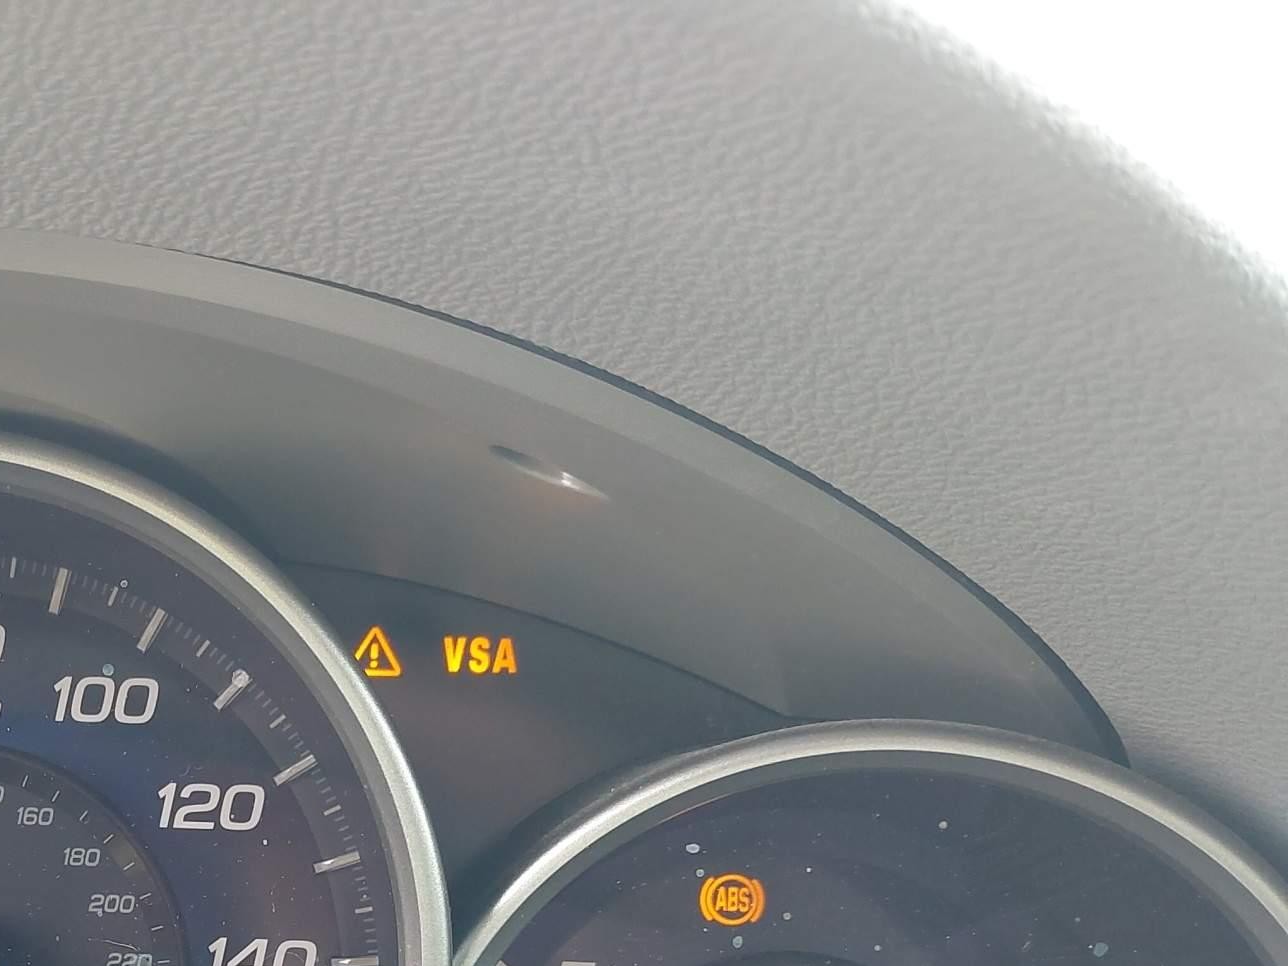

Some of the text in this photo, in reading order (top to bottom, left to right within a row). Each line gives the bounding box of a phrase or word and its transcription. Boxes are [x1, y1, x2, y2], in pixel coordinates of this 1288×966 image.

[443, 635, 517, 673] VSA
[53, 676, 159, 724] 100
[17, 806, 54, 826] 160
[157, 782, 265, 831] 120
[63, 847, 101, 867] 180
[88, 894, 136, 914] 200
[715, 886, 750, 912] ABS
